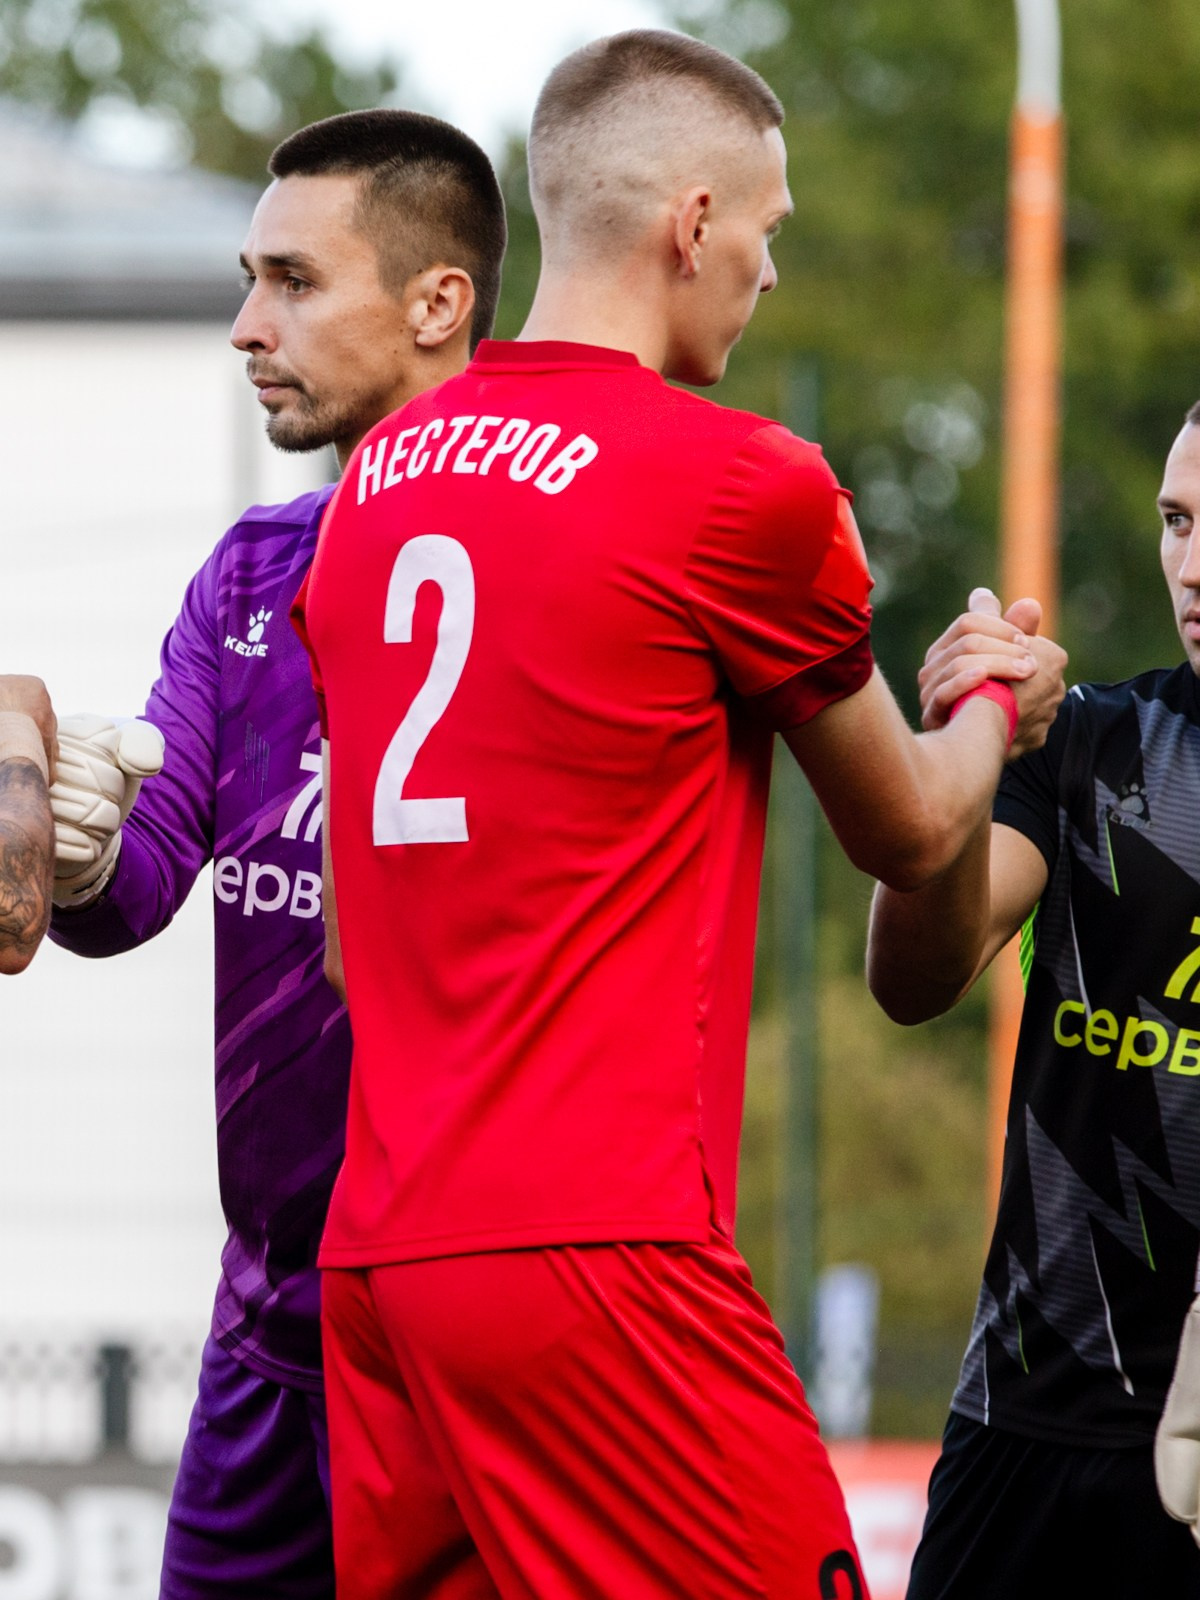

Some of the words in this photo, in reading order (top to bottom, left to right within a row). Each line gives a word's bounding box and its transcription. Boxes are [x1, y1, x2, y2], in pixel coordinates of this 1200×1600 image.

[357, 415, 599, 506] НЕСТЕРОВ
[373, 533, 476, 847] 2
[213, 855, 325, 921] ерв
